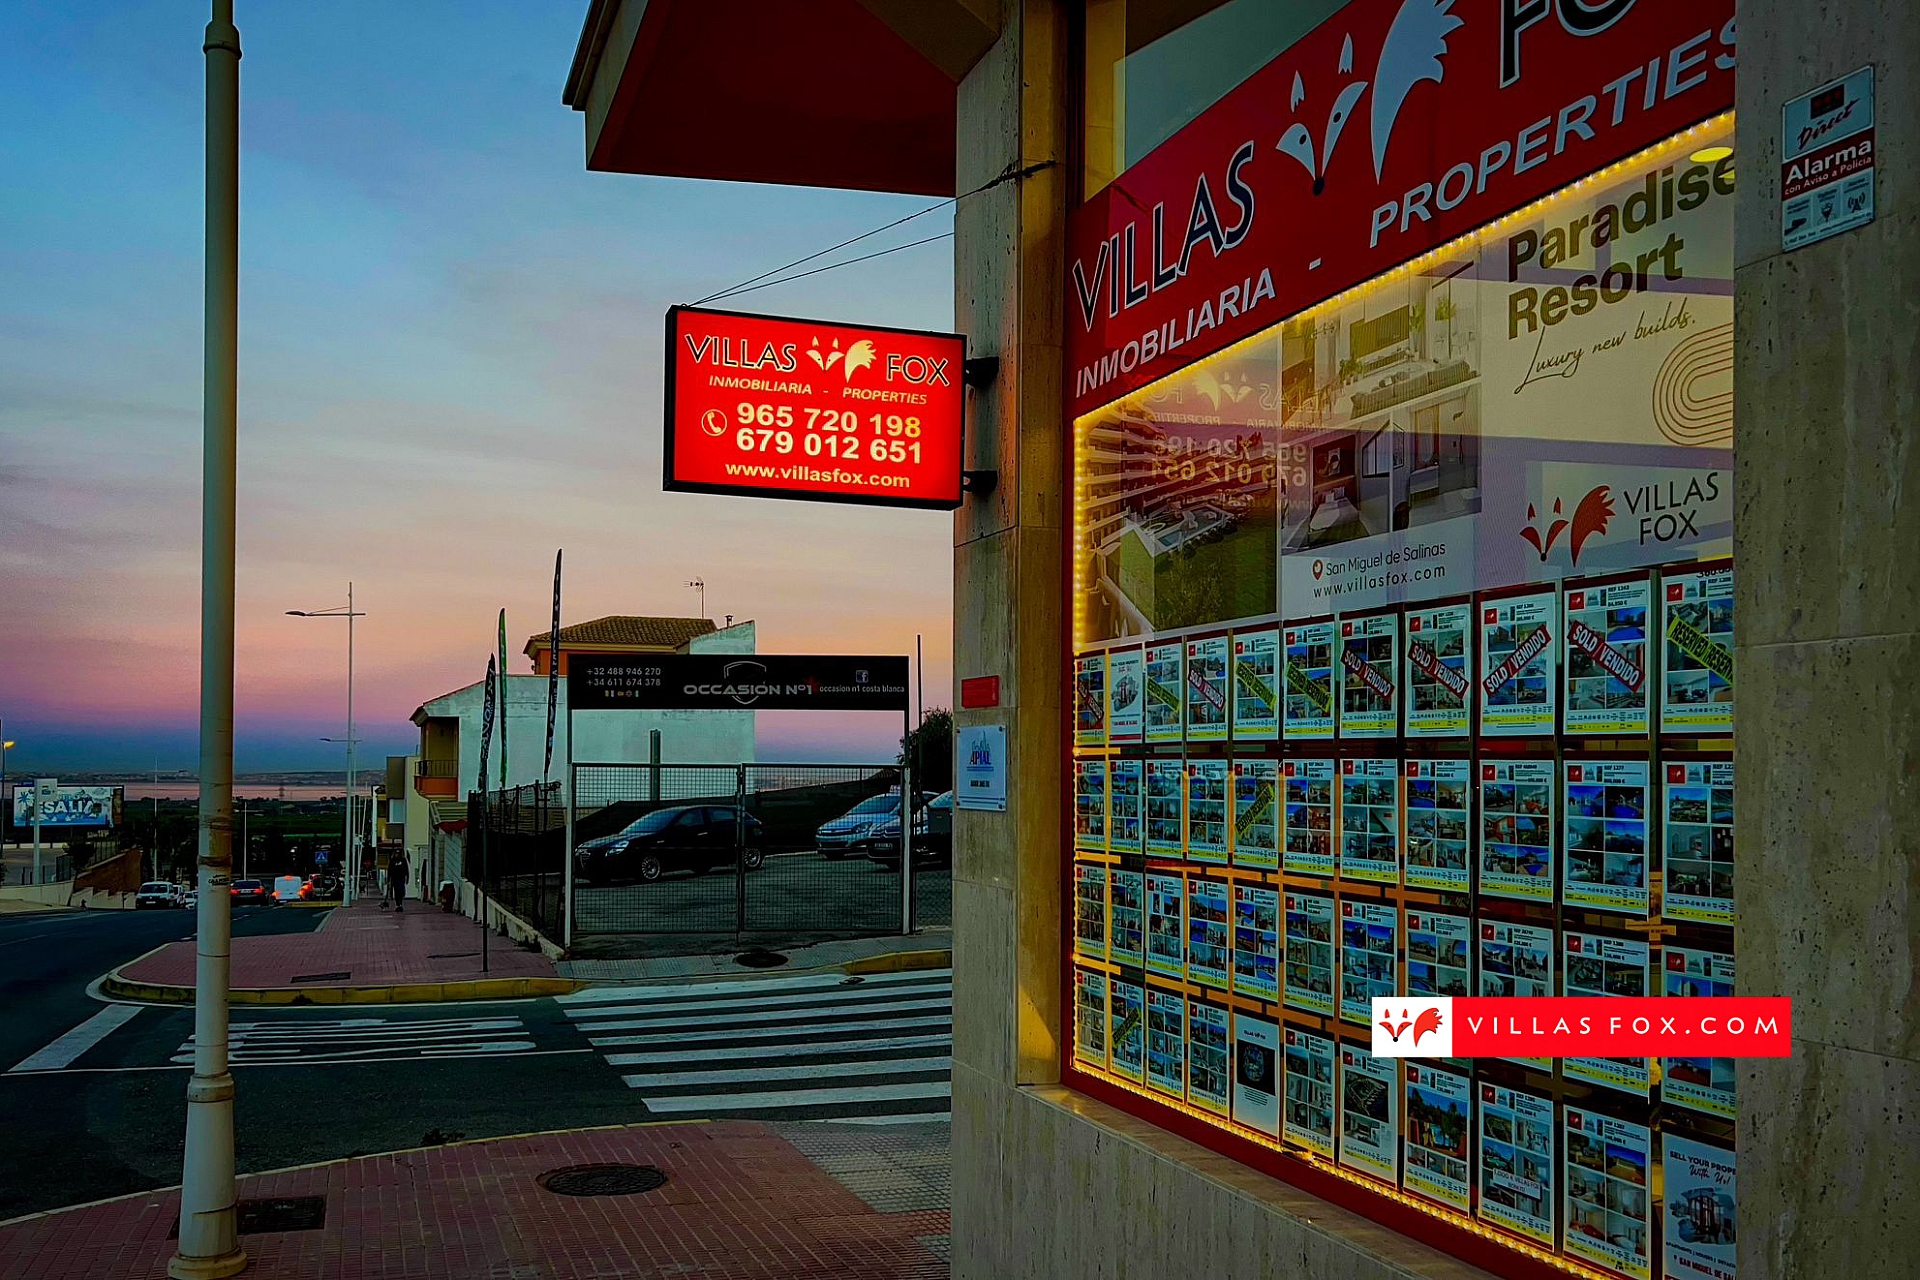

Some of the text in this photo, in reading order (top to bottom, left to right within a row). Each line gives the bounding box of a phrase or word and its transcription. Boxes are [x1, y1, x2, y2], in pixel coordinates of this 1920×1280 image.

[1797, 98, 1860, 150] Direct
[1786, 140, 1872, 185] Alarma
[1785, 184, 1800, 195] con
[1804, 173, 1829, 189] Aviso
[1072, 140, 1254, 332] VILLAS
[1508, 154, 1734, 283] Paradise
[1508, 232, 1684, 340] Resort
[1075, 267, 1276, 398] INMOBILIARIA
[1514, 296, 1696, 395] Luxury new builds.
[685, 333, 950, 386] VILLAS FOX
[709, 375, 812, 395] INMOBILIARIA
[843, 387, 927, 405] PROPERTIES
[736, 402, 921, 438] 965 720 198
[736, 428, 921, 464] 679 012 651
[725, 464, 910, 488] www.villasfox.com
[1623, 472, 1719, 515] VILLAS
[1640, 509, 1699, 546] FOX
[1326, 543, 1446, 576] San Miguel de Salinas
[1313, 565, 1446, 598] www.villasfox.com
[1344, 650, 1361, 671] SOLD
[1364, 665, 1391, 696] VENDIDO
[1412, 645, 1465, 694] SOLD VENDIDO
[1486, 629, 1546, 692] SOLD VENDIDO
[1573, 624, 1640, 686] SOLD VENDIDO
[586, 678, 661, 686] +34 611 674 378
[819, 684, 850, 692] occasion
[882, 684, 904, 692] blanca
[1670, 1151, 1686, 1162] SELL
[1688, 1156, 1709, 1168] YOUR
[1689, 1165, 1710, 1179] With
[1714, 1266, 1722, 1277] DE
